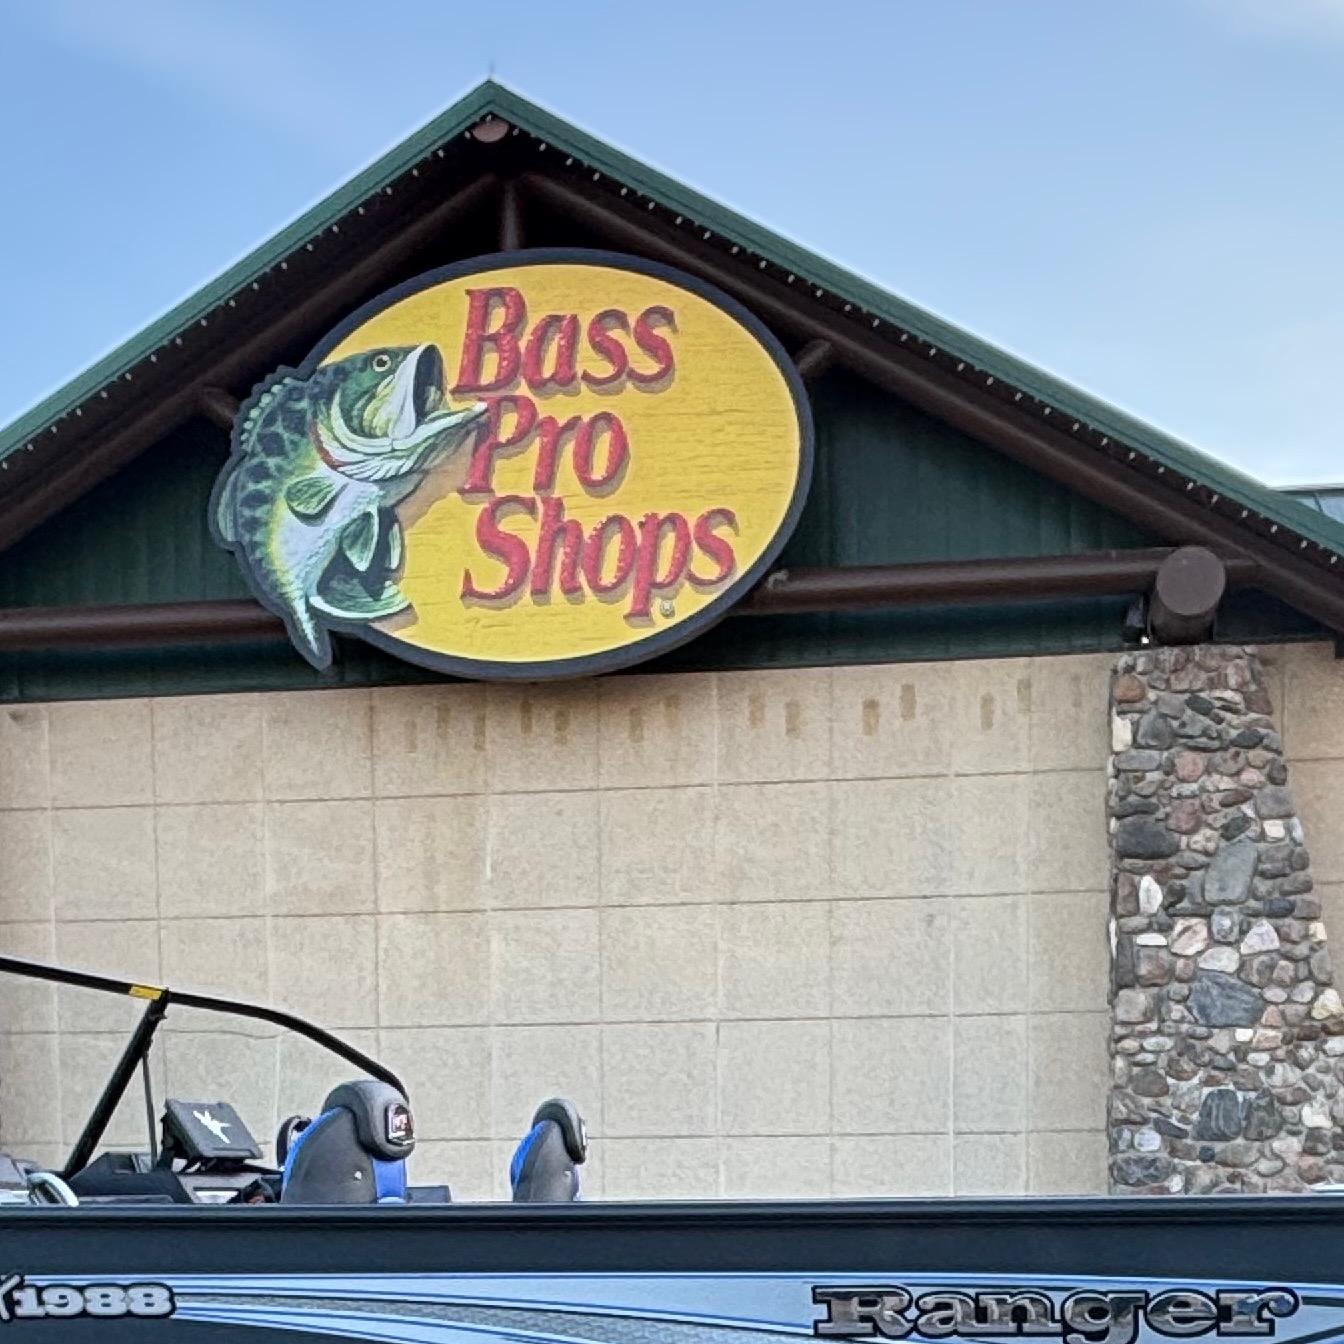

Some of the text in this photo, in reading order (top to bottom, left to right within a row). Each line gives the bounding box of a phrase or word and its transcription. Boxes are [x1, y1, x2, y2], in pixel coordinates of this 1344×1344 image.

[450, 286, 676, 395] Bass
[457, 395, 630, 497] Pro
[460, 495, 738, 625] Shops
